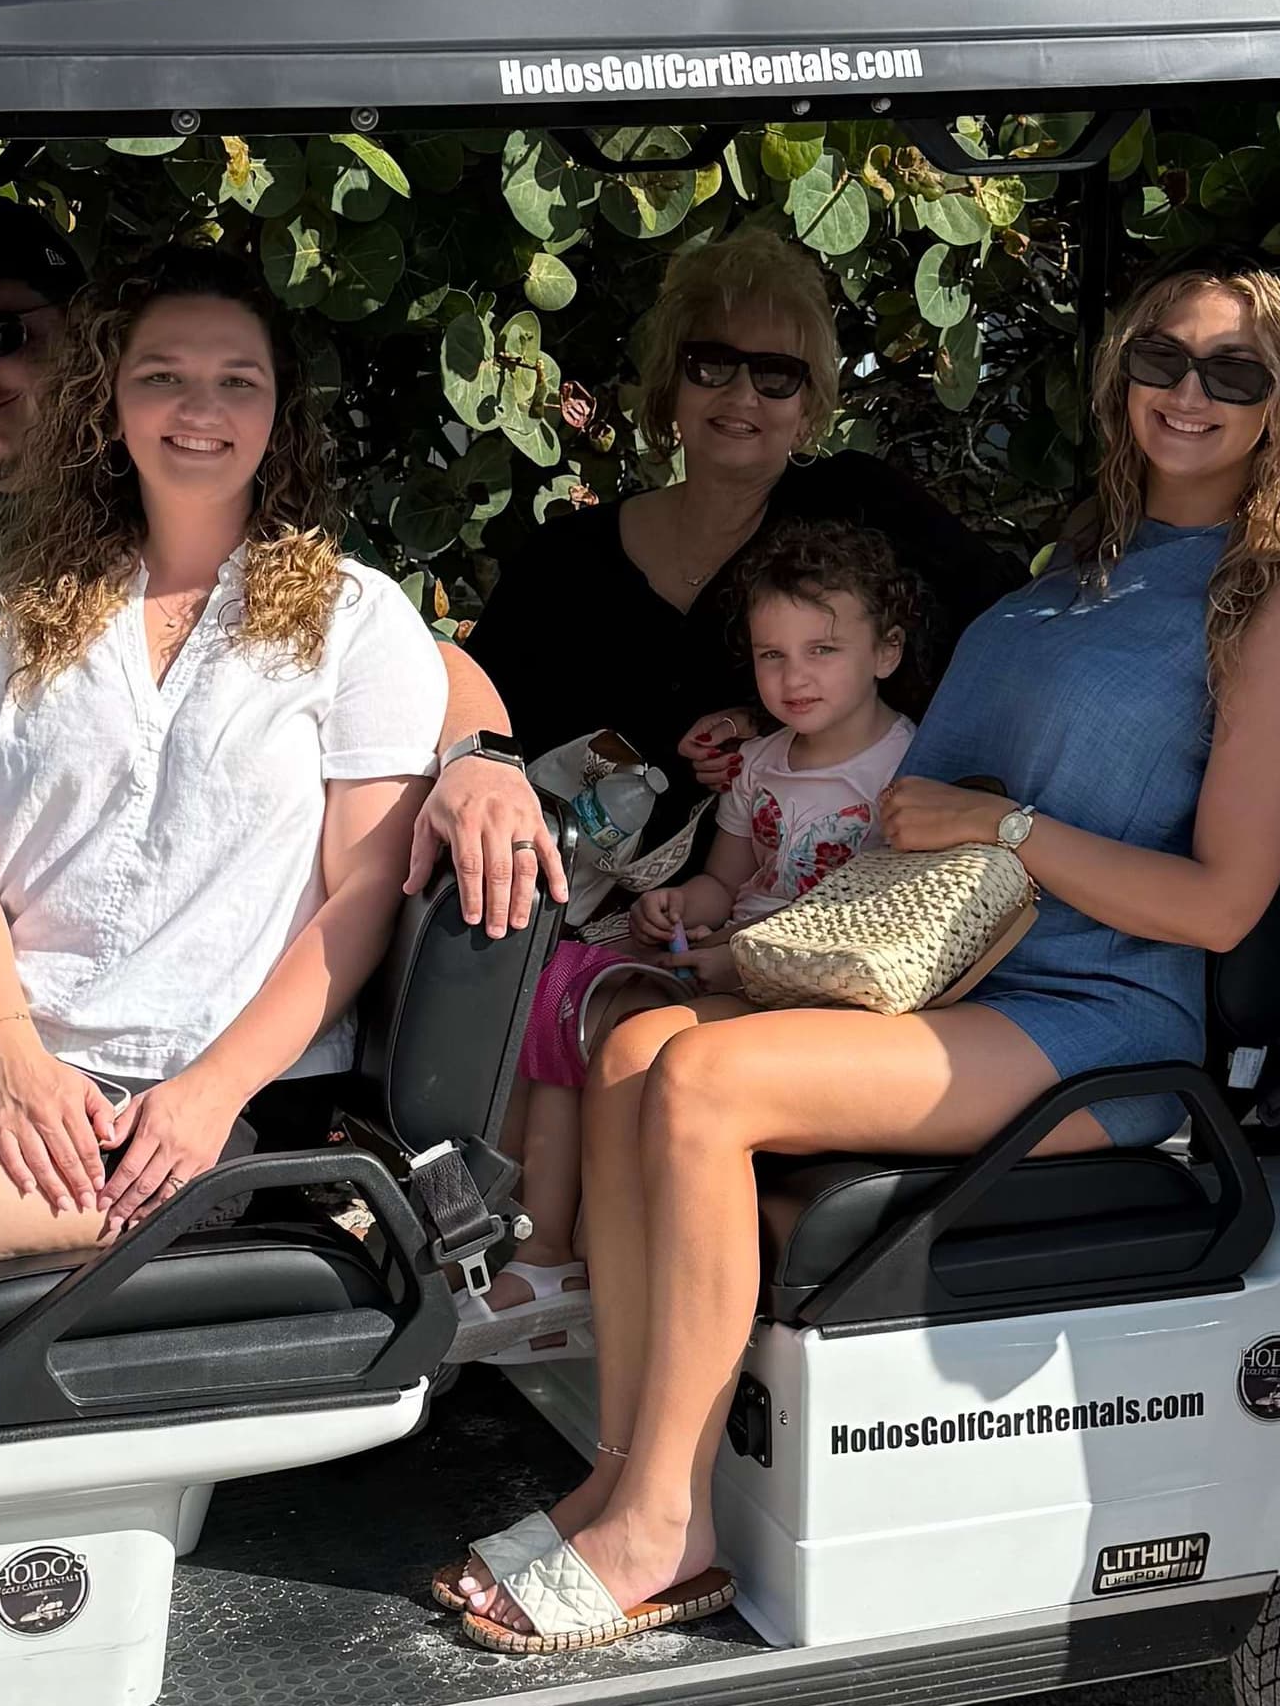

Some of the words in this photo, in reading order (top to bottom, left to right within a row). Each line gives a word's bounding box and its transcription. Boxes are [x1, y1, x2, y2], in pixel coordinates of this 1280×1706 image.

[499, 48, 923, 95] HodosGolfCartRentals.com
[831, 1392, 1204, 1455] HodosGolfCartRentals.com
[1102, 1537, 1204, 1571] LITHIUM
